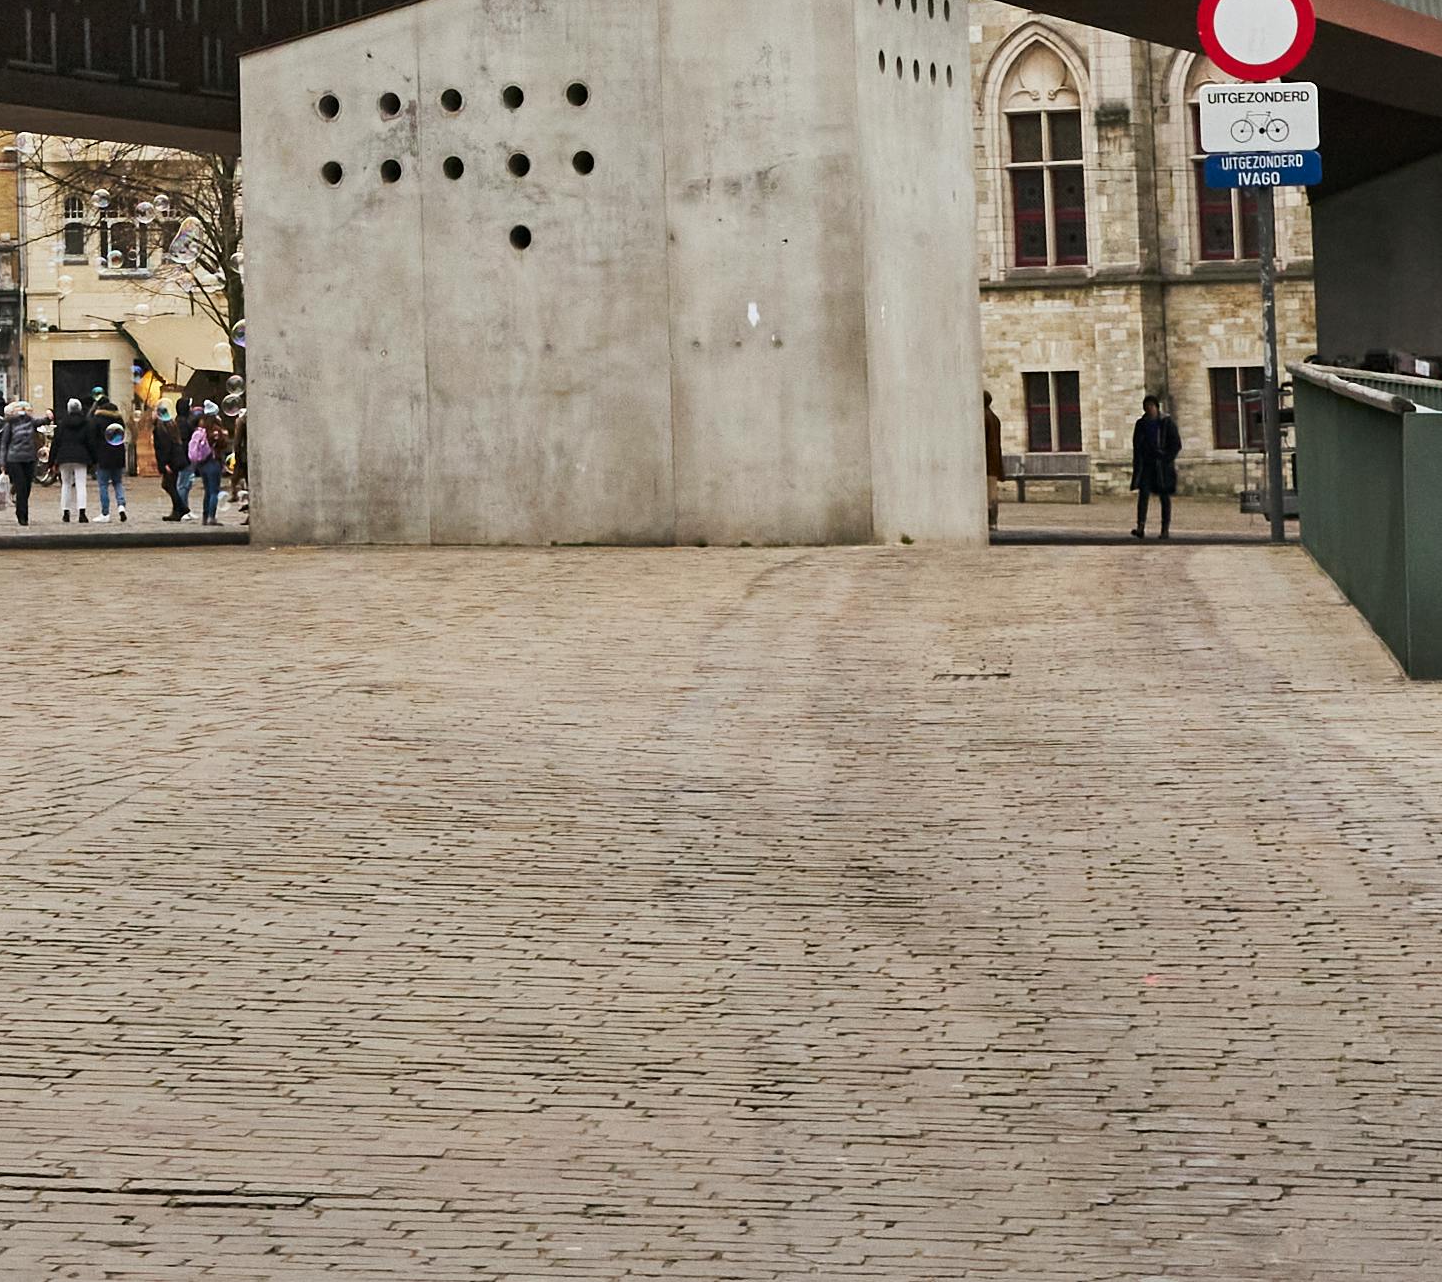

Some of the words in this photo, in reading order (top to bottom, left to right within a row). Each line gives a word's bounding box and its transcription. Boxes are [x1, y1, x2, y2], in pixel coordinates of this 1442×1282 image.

[1207, 91, 1310, 104] UITGEZONDERD
[1221, 154, 1303, 170] UITGEZONDERD
[1238, 171, 1281, 186] IVAGO
